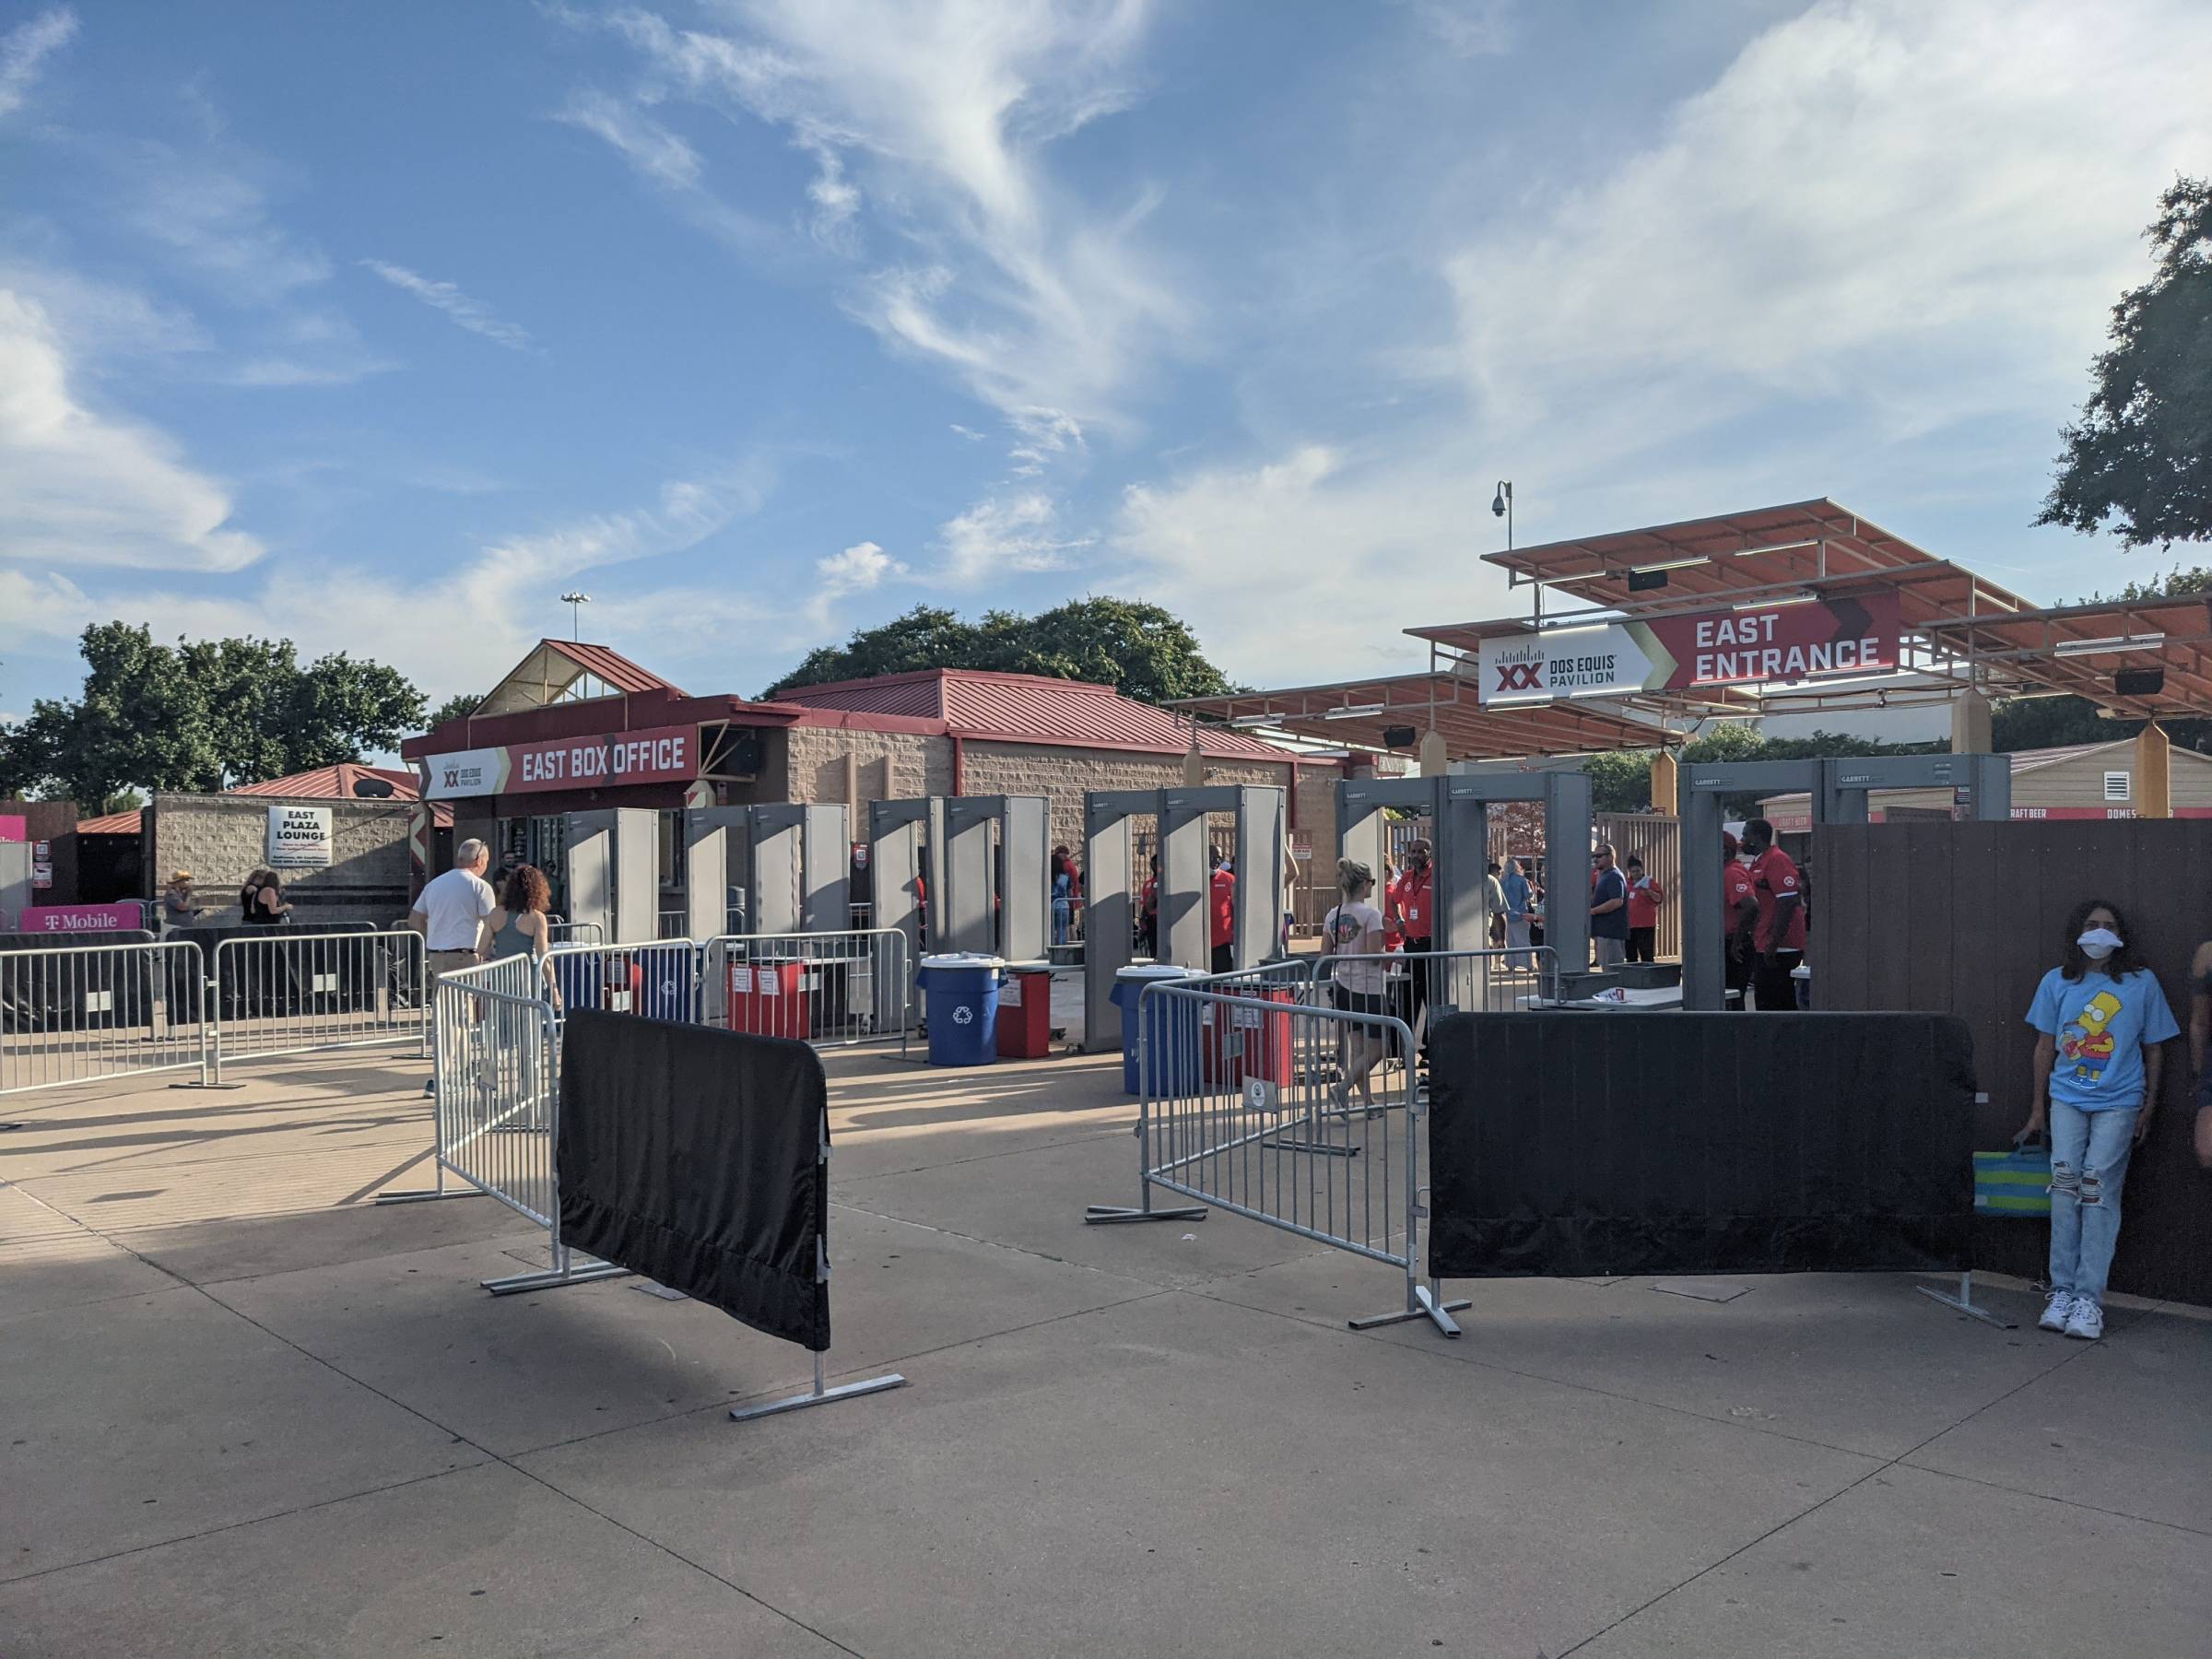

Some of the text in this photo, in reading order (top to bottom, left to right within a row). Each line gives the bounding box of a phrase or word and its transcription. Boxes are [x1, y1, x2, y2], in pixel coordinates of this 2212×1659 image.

[1696, 613, 1779, 648] EAST
[1550, 654, 1615, 675] DOS EQUIS
[1696, 637, 1879, 681] ENTRANCE
[1496, 662, 1544, 691] XX
[1549, 671, 1615, 688] PAVILION
[523, 736, 685, 782] EAST BOX OFFICE
[288, 810, 314, 819] EAST
[2010, 808, 2047, 819] RAFT BEER
[2107, 808, 2137, 819] DOMES
[283, 820, 320, 830] PLAZA
[276, 830, 325, 841] LOUNGE
[63, 912, 118, 929] Mobile
